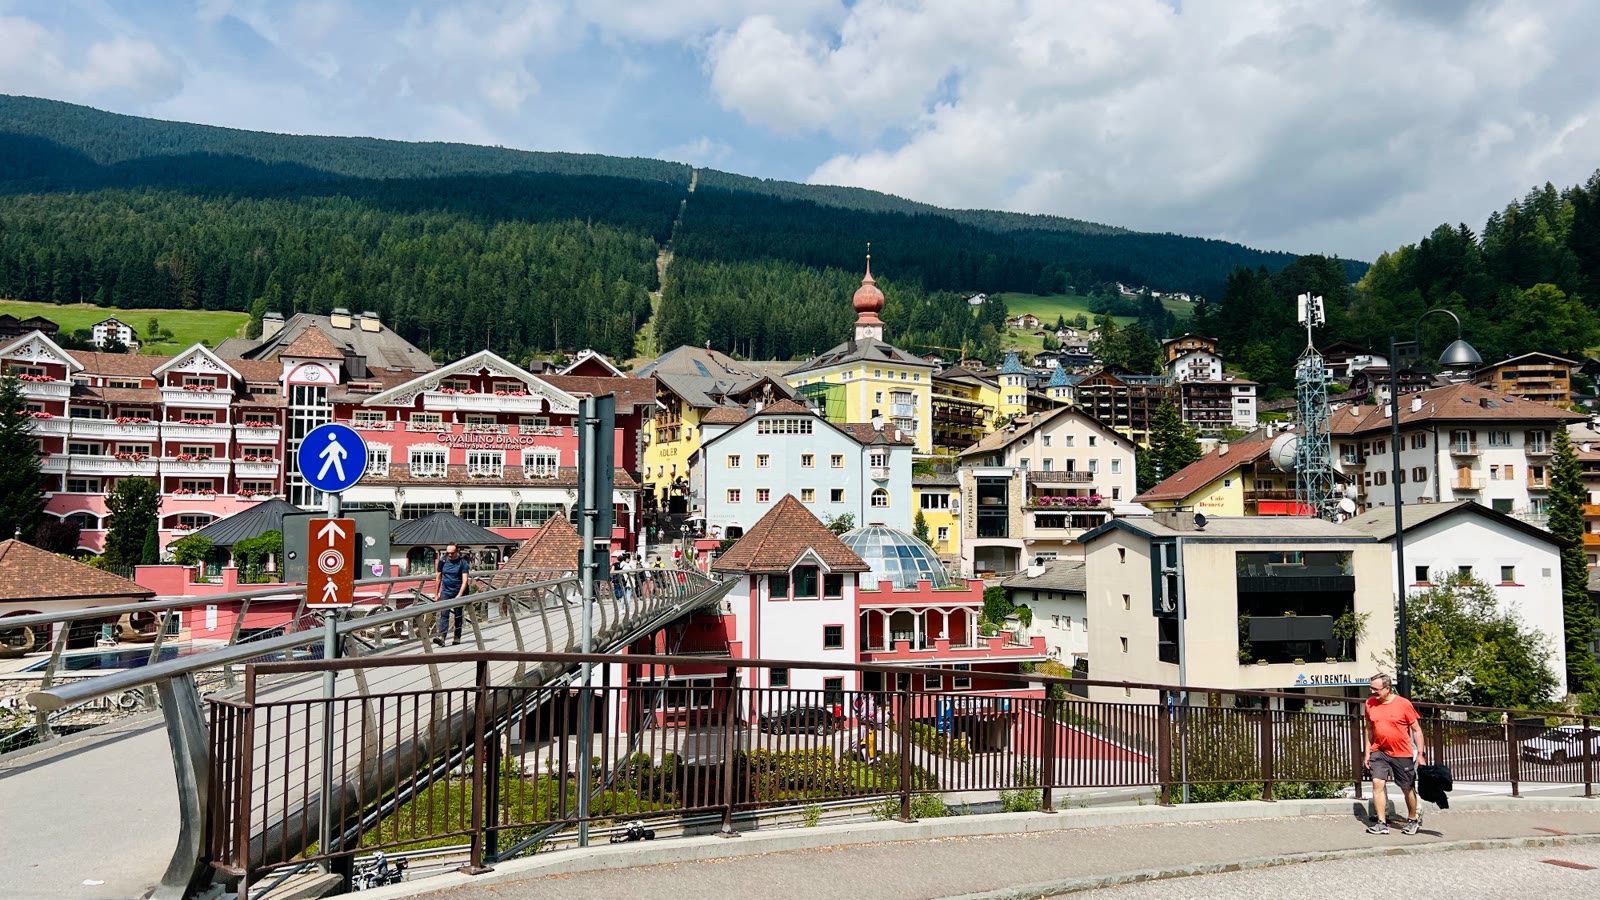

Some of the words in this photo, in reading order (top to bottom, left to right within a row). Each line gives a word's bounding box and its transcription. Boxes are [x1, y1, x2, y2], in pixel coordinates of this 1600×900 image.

[437, 433, 493, 443] CAVALLINO
[496, 435, 534, 444] BIANCO
[659, 447, 678, 457] ADLER
[1310, 674, 1323, 685] SKI
[1324, 674, 1352, 685] RENTAL
